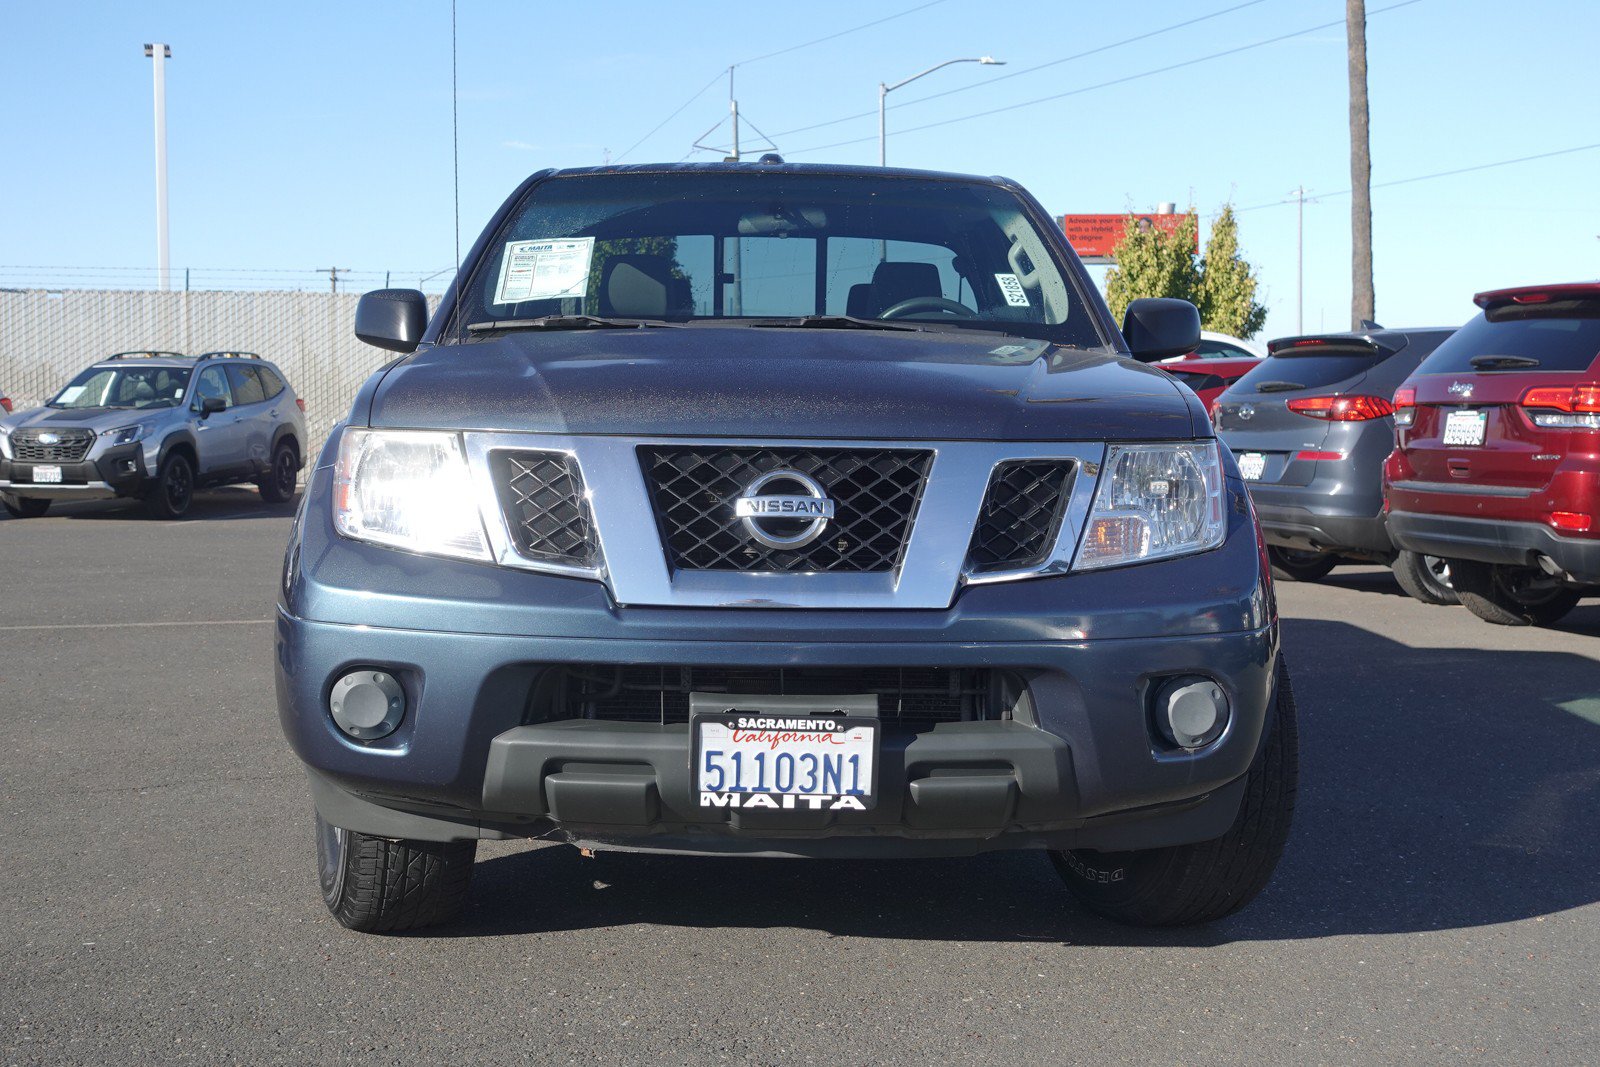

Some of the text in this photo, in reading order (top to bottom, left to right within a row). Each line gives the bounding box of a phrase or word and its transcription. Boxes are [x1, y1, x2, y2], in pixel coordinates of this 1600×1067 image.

[1001, 277, 1026, 303] S21858
[746, 500, 823, 513] NISSAN
[737, 717, 836, 731] SACRAMENTO
[732, 729, 846, 750] California
[705, 750, 865, 796] 51103N1
[699, 791, 867, 810] MAITA
